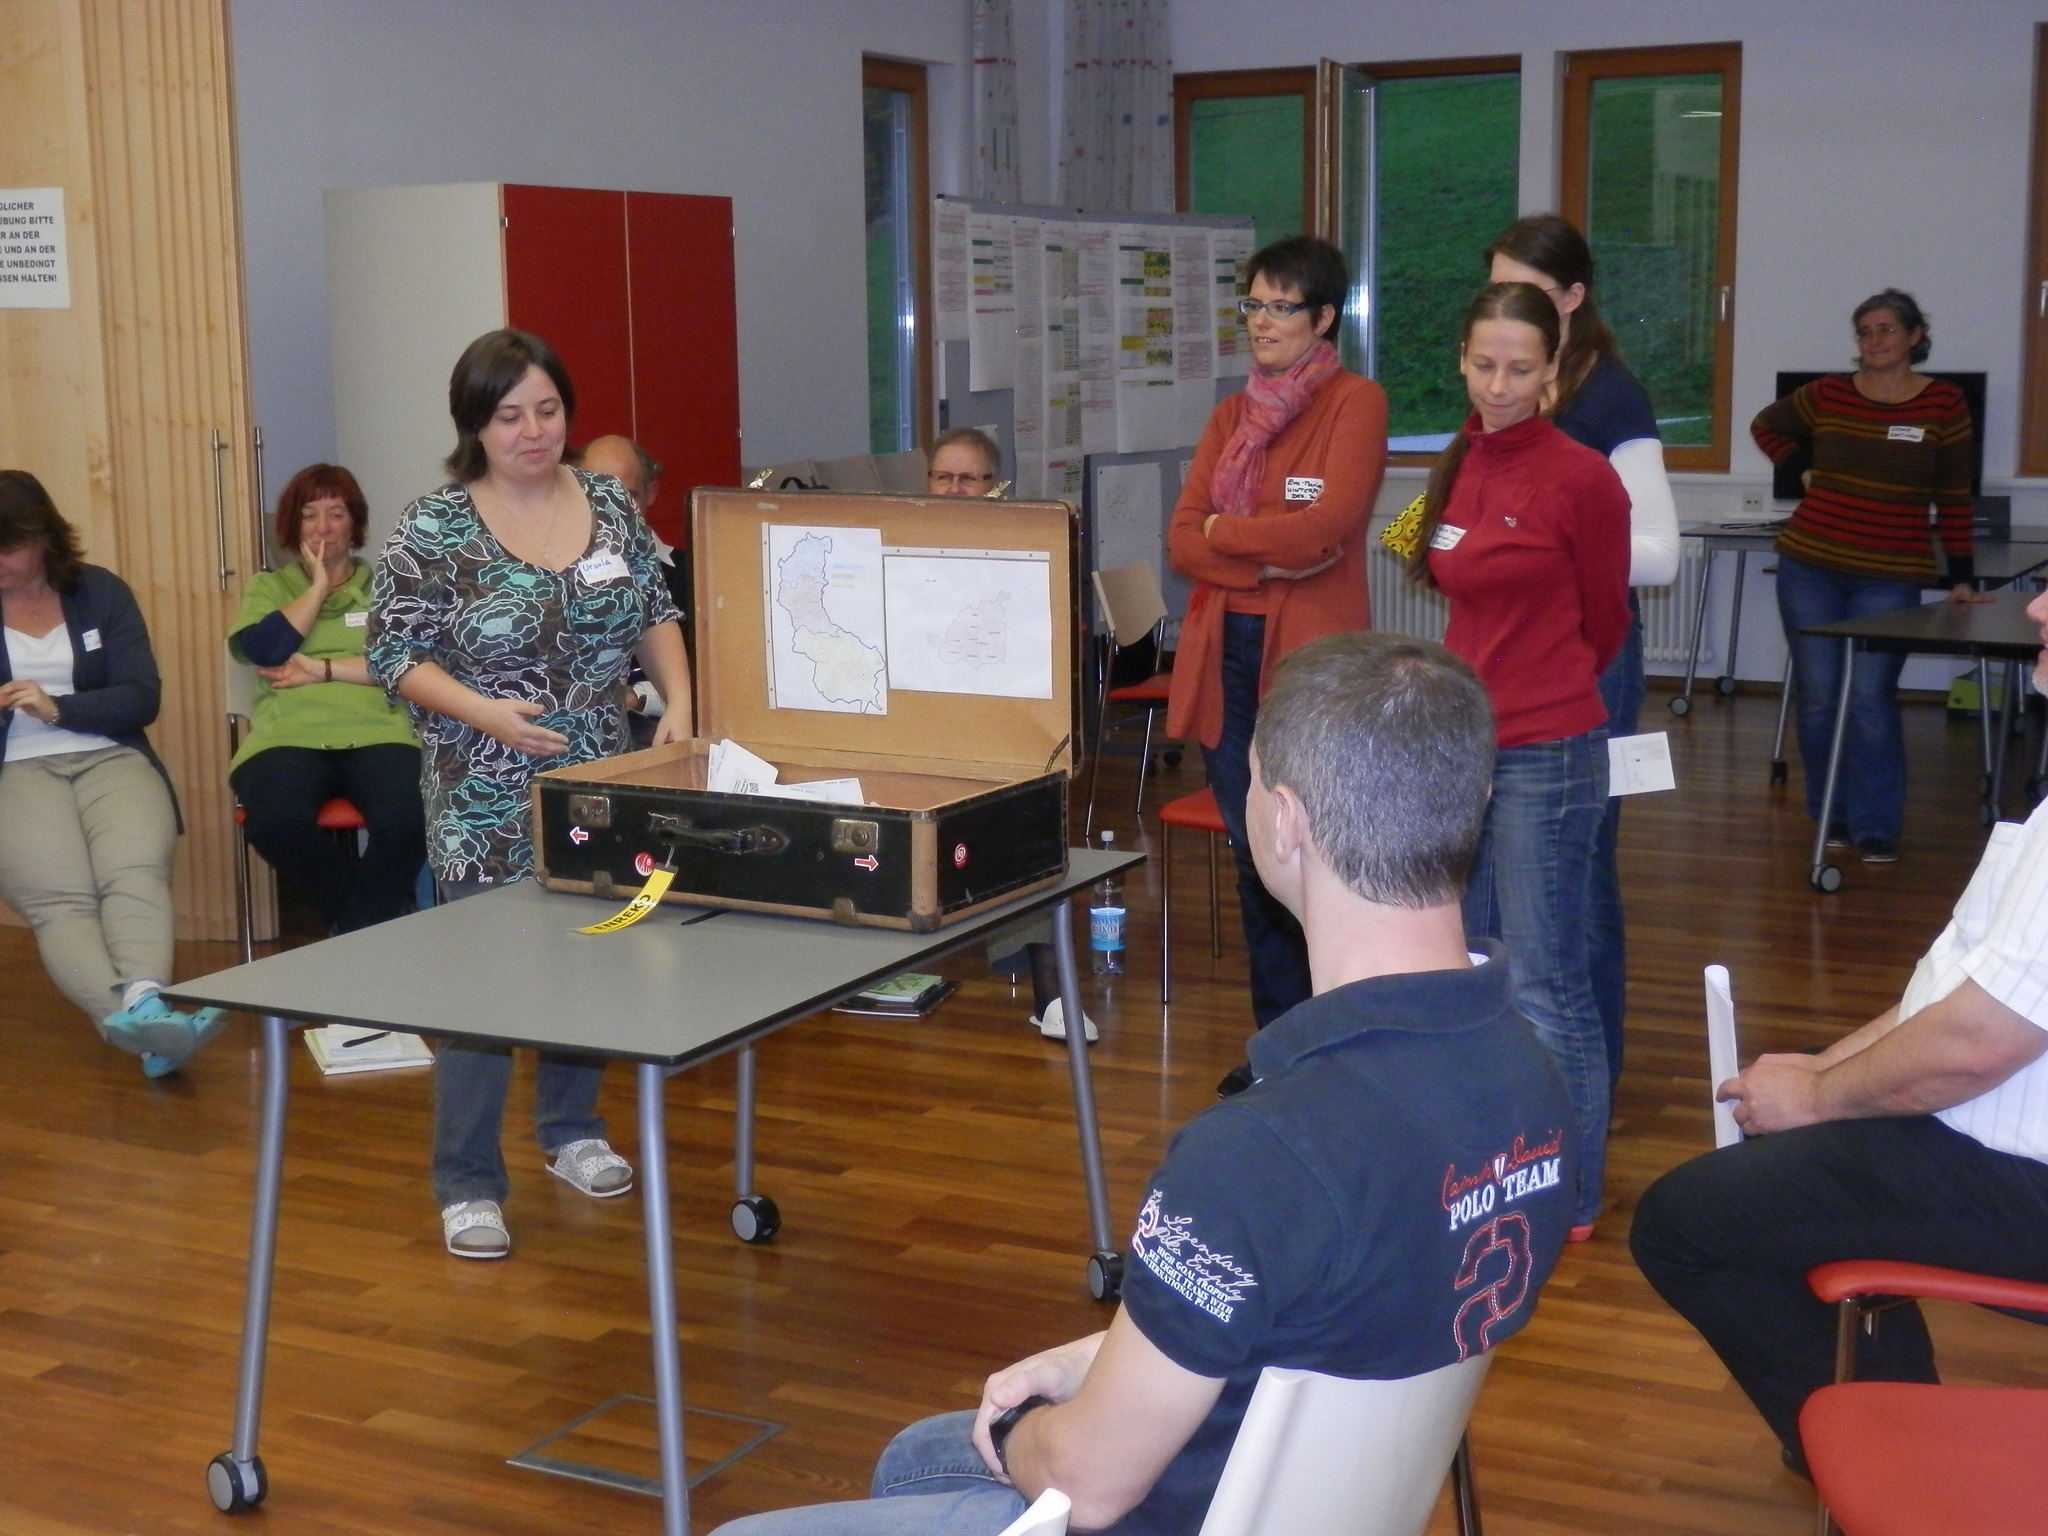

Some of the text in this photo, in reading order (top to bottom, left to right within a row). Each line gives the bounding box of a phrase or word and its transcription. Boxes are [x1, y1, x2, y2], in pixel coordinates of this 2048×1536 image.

[9, 231, 20, 239] AN
[23, 230, 40, 239] DER
[29, 216, 54, 225] BITTE
[5, 246, 22, 254] UND
[25, 246, 36, 254] AN
[39, 245, 56, 253] DER
[7, 260, 55, 268] UNBEDINGT
[21, 274, 57, 282] HALTEN!
[582, 558, 612, 572] Ursula
[1449, 1157, 1561, 1231] POLO TEAM
[1163, 1214, 1259, 1287] Legendary
[1142, 1253, 1232, 1323] INTERNATIONAL PLAYERS
[1148, 1248, 1234, 1315] SEE EIGHT TEAMS WITH
[1156, 1245, 1230, 1302] HIGH GOAL TROPHY
[1185, 1253, 1247, 1302] Trophy
